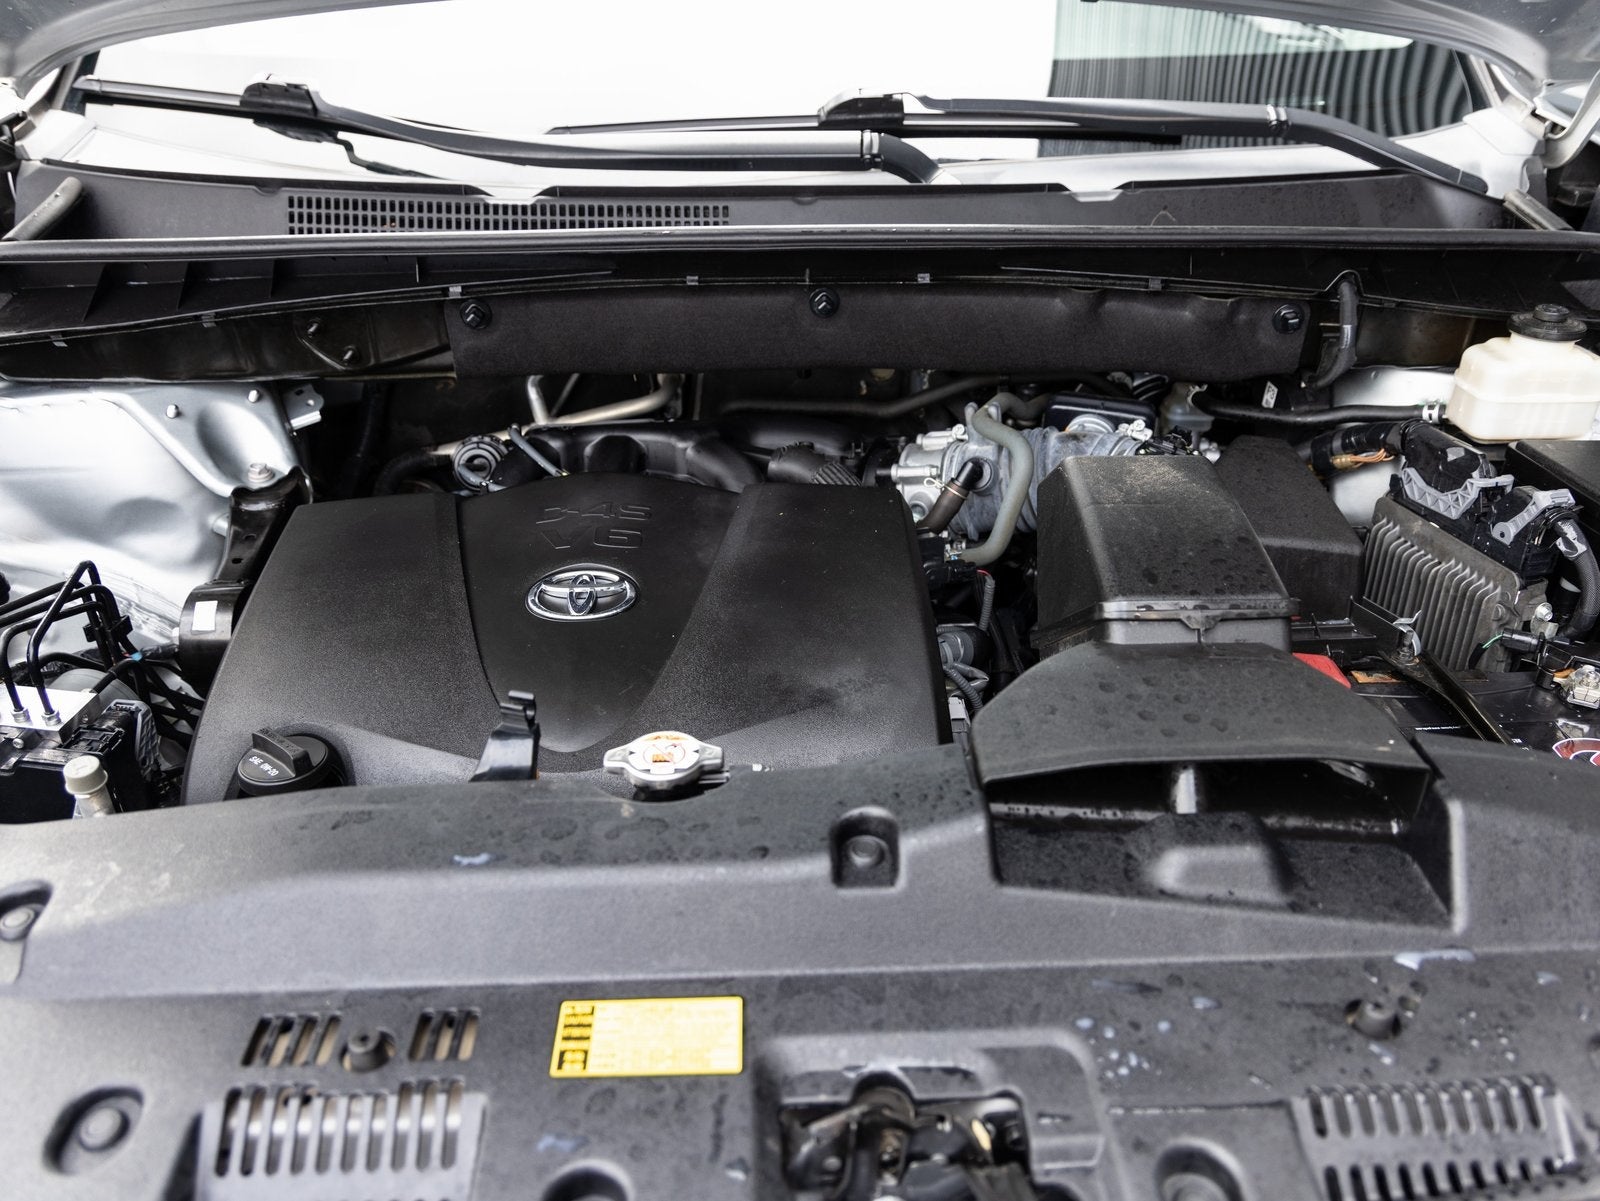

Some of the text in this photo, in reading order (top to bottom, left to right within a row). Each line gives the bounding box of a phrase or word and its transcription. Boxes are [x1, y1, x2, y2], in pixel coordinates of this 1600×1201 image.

[539, 525, 643, 549] V6
[249, 756, 279, 776] SAE 0W-20
